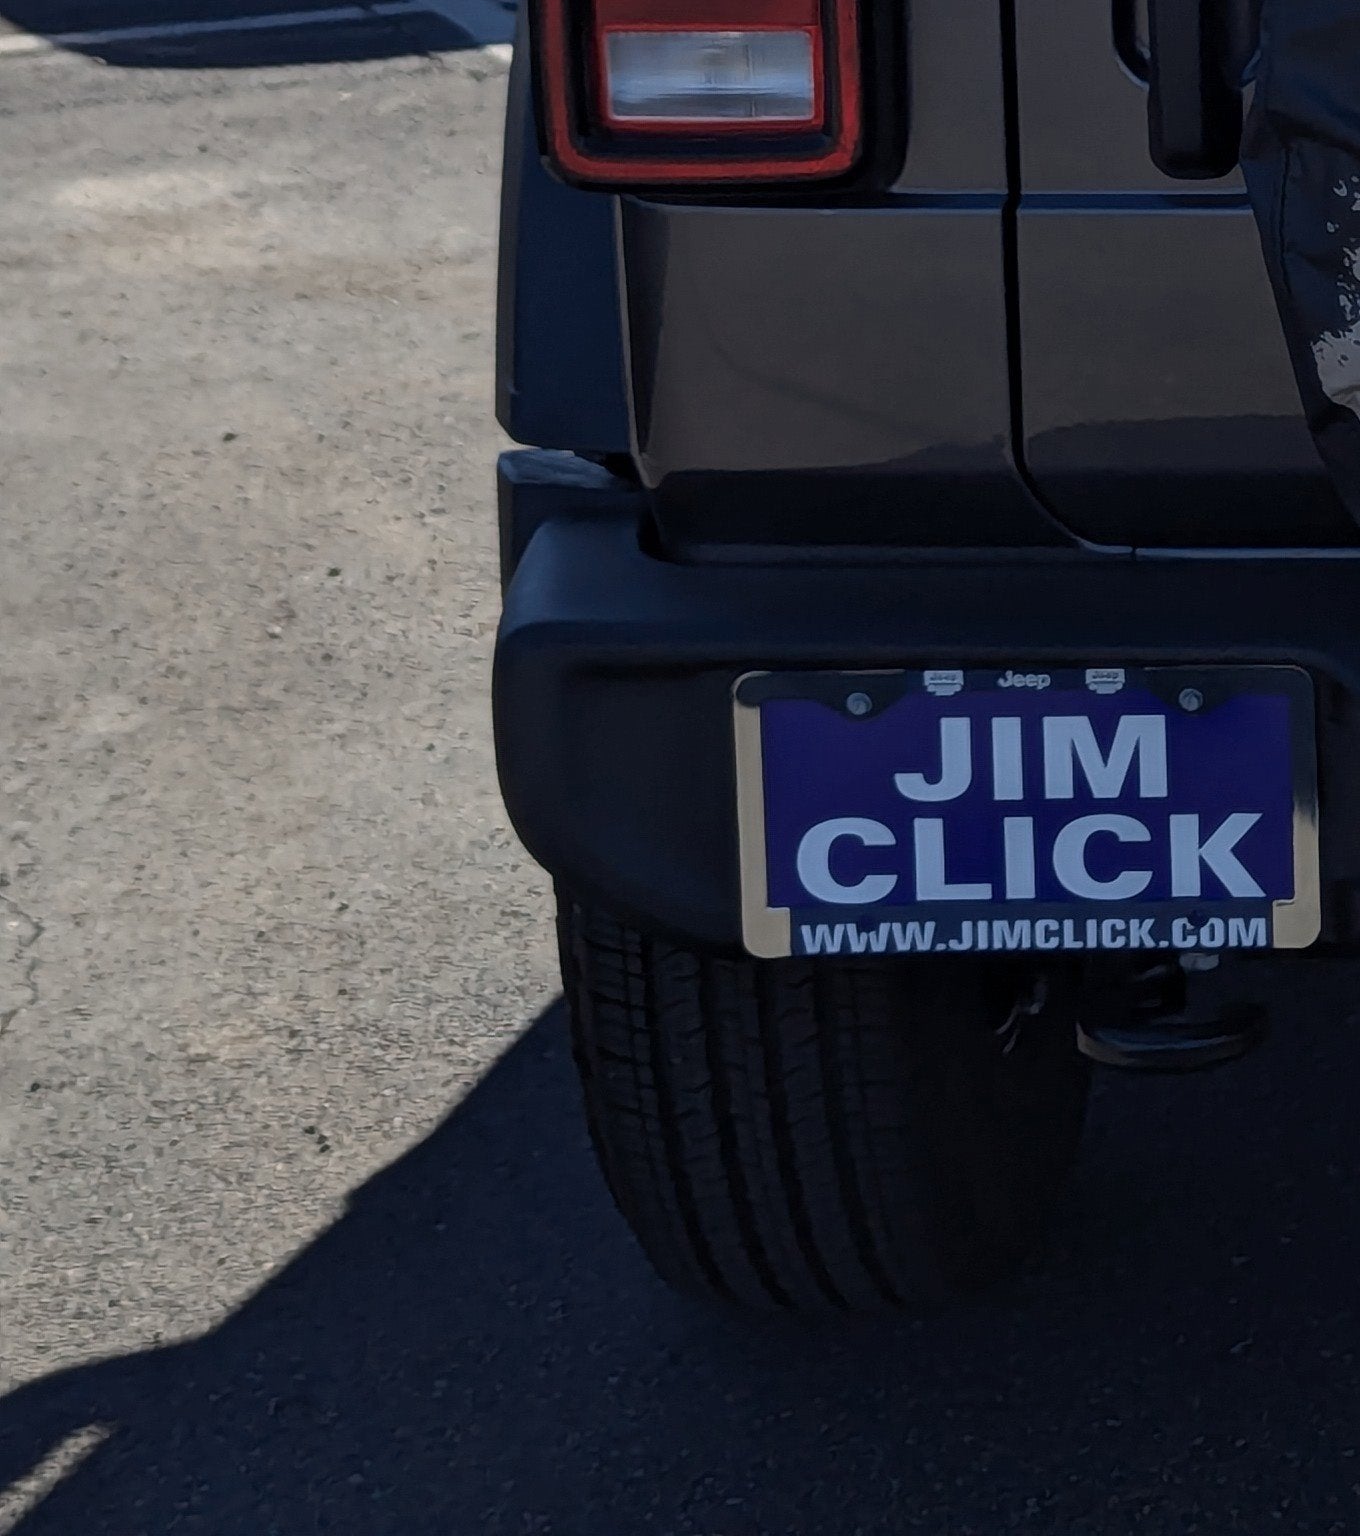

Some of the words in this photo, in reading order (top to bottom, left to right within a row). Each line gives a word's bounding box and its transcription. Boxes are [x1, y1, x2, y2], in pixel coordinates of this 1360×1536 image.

[997, 670, 1051, 690] Jeep
[894, 714, 1169, 803] JIM
[796, 812, 1267, 904] CLICK
[800, 917, 1267, 955] WWW.JIMCLICK.COM
